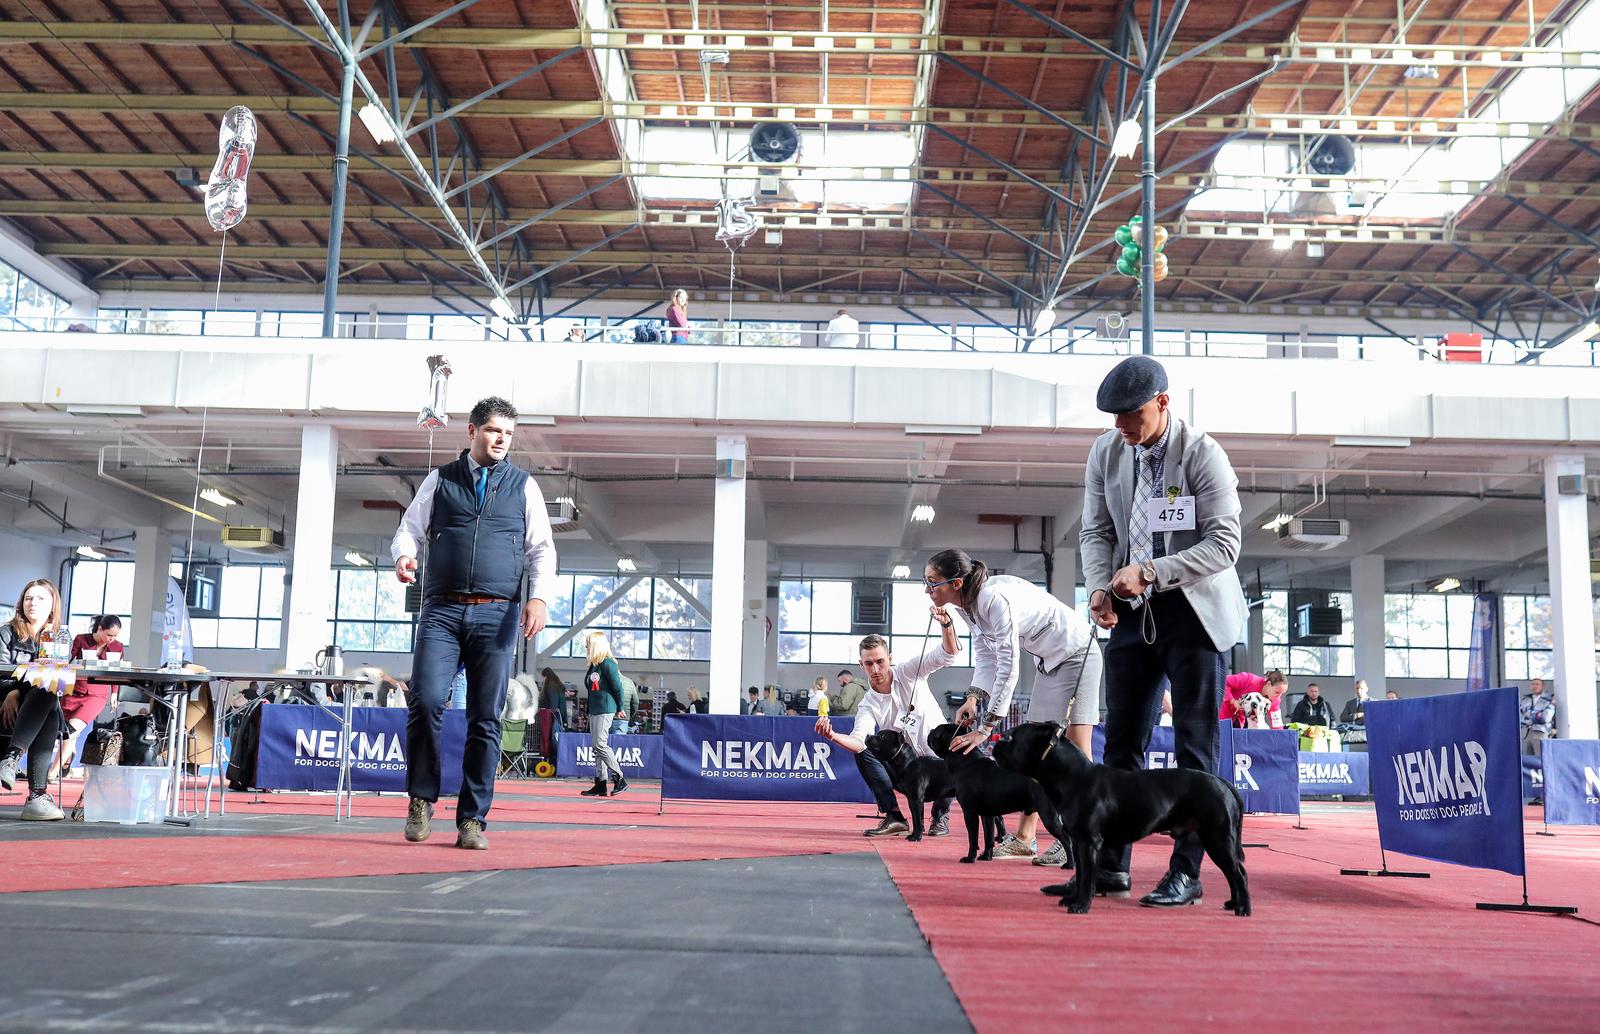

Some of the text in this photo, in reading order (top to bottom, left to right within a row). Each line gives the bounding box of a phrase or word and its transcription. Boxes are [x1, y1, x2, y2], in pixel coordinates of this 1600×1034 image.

[1158, 508, 1185, 522] 475
[295, 728, 406, 762] NEKMA
[294, 758, 313, 766] FOR
[315, 760, 340, 768] DOGS
[357, 762, 378, 770] DOG
[380, 763, 408, 771] PEOP
[576, 746, 645, 768] NEMAR
[701, 740, 837, 780] NEKMAR
[701, 770, 720, 778] FOR
[789, 772, 826, 780] PEOPLE
[1299, 763, 1353, 784] EKMAR
[1392, 740, 1491, 816] NEKMAR
[1400, 809, 1414, 821] FOR
[1415, 808, 1431, 821] DOGS
[1440, 805, 1459, 818] DOG
[1459, 802, 1483, 817] PEOPLE
